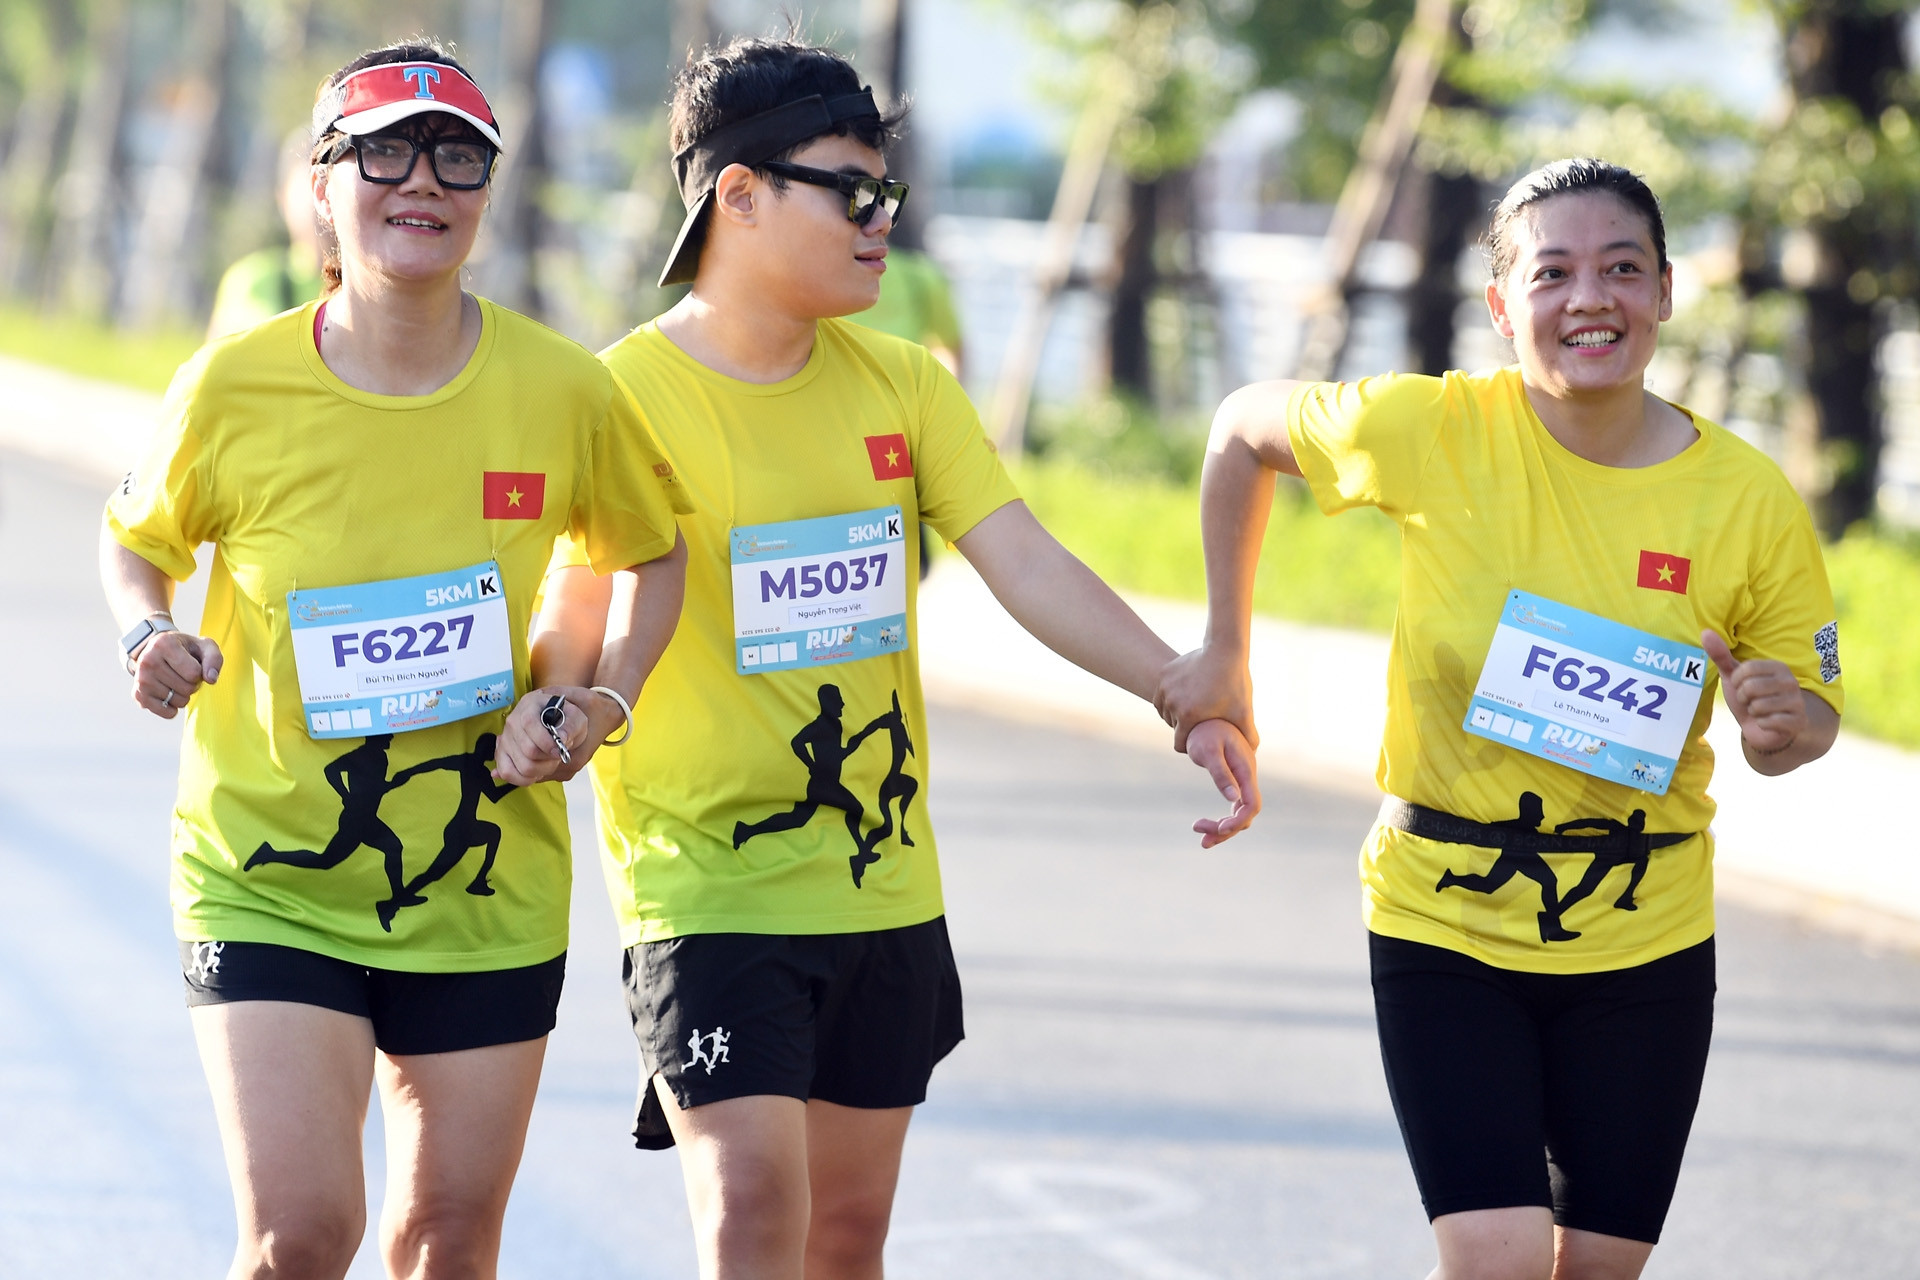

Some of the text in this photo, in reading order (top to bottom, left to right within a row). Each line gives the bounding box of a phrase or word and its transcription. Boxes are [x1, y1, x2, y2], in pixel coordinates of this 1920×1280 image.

[403, 67, 441, 99] T
[848, 522, 883, 544] 5KM
[887, 518, 900, 537] K
[480, 576, 497, 596] K
[760, 553, 888, 603] M5037
[425, 582, 473, 607] 5KM
[331, 614, 475, 668] F6227
[806, 625, 853, 650] RUN
[1632, 645, 1681, 675] 5KM
[1685, 661, 1701, 681] K
[1522, 645, 1668, 721] F6242
[381, 689, 437, 717] RUN
[1566, 704, 1592, 718] Thanh
[1593, 713, 1610, 724] Nga
[1541, 722, 1601, 753] RUN
